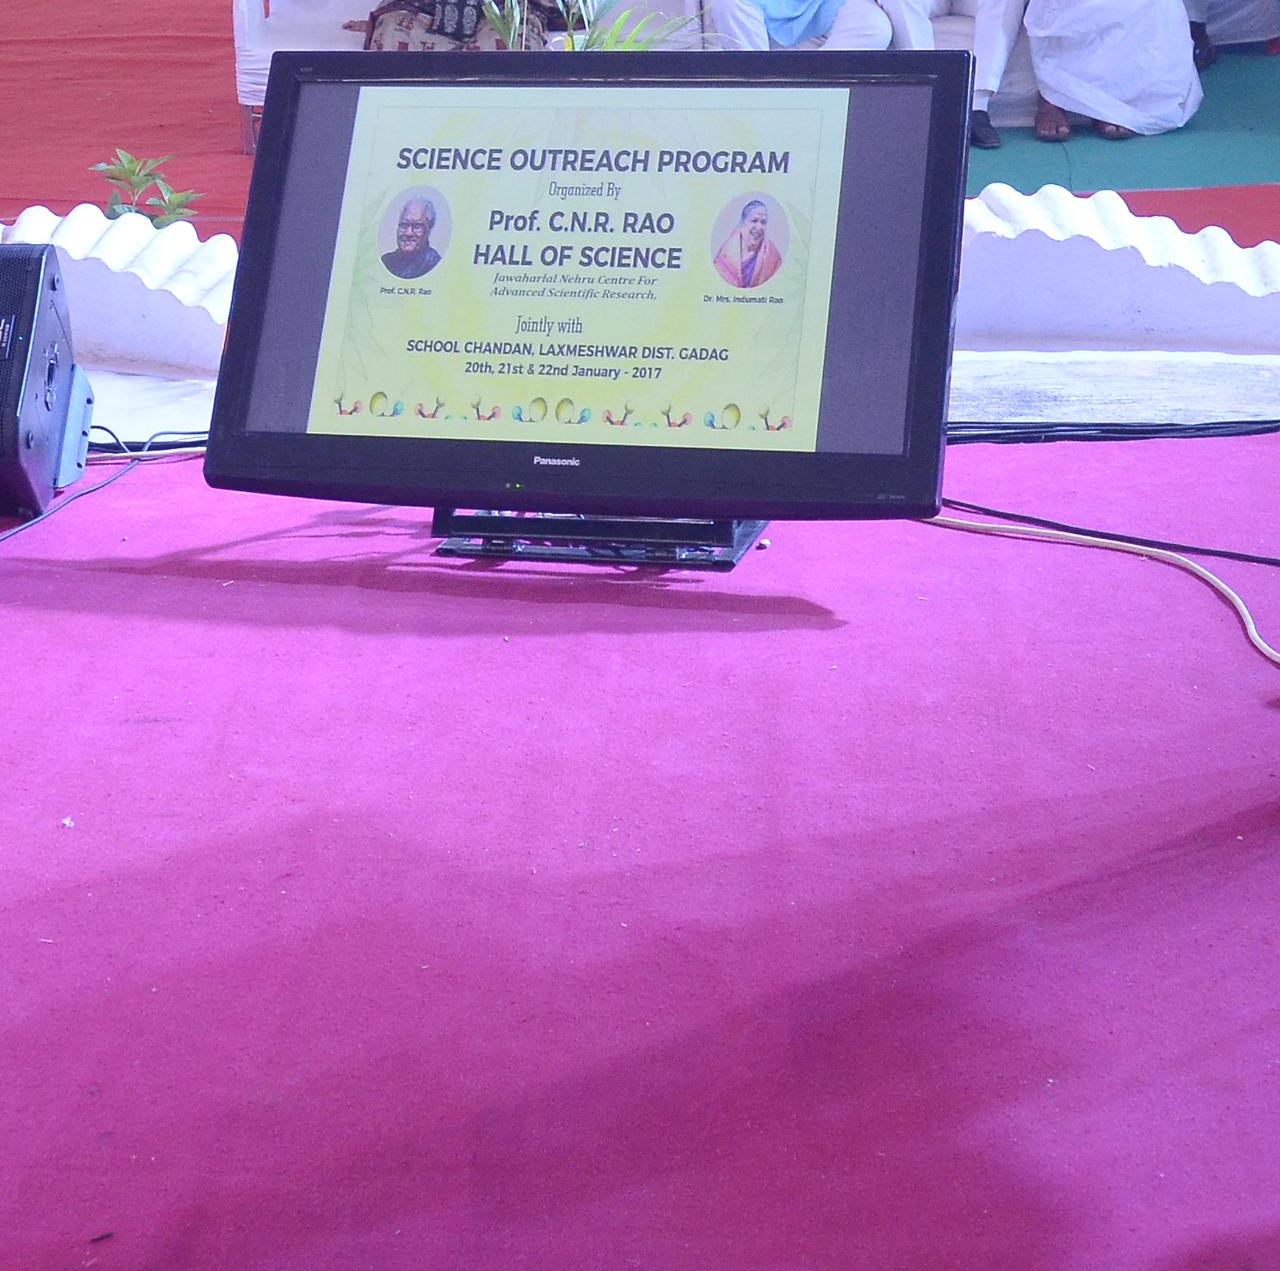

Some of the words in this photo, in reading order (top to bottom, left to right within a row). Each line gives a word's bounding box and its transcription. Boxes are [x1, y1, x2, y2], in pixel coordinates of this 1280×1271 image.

[396, 147, 503, 171] SCIENCE
[509, 148, 650, 172] OUTREACH
[657, 150, 790, 174] PROGRAM
[548, 181, 603, 200] Organized
[606, 182, 622, 200] By
[488, 209, 541, 232] Prof.
[549, 211, 614, 233] C.N.R.
[622, 212, 675, 234] RAO
[473, 243, 533, 266] HALL
[540, 245, 573, 267] OF
[578, 246, 683, 269] SCIENCE
[493, 272, 557, 285] Jawaharlal
[559, 274, 594, 285] Nehru
[597, 275, 635, 286] Centre
[637, 275, 658, 286] For
[418, 287, 432, 296] Rao
[490, 286, 546, 298] Advanced
[547, 287, 600, 300] Scientific
[732, 295, 767, 304] Indumati
[768, 296, 784, 305] Rao
[515, 315, 554, 337] Jointly
[557, 316, 583, 334] with
[406, 339, 460, 354] SCHOOL
[464, 341, 535, 357] CHANDAN,
[538, 343, 638, 359] LAXMESHWAR
[641, 346, 675, 360] DIST.
[679, 348, 729, 362] GADAG
[464, 362, 494, 375] 20th,
[497, 363, 523, 375] 21st
[526, 364, 534, 375] &
[538, 364, 568, 376] 22nd
[571, 365, 620, 380] January
[632, 366, 662, 379] 2017
[533, 456, 580, 466] Panasonic
